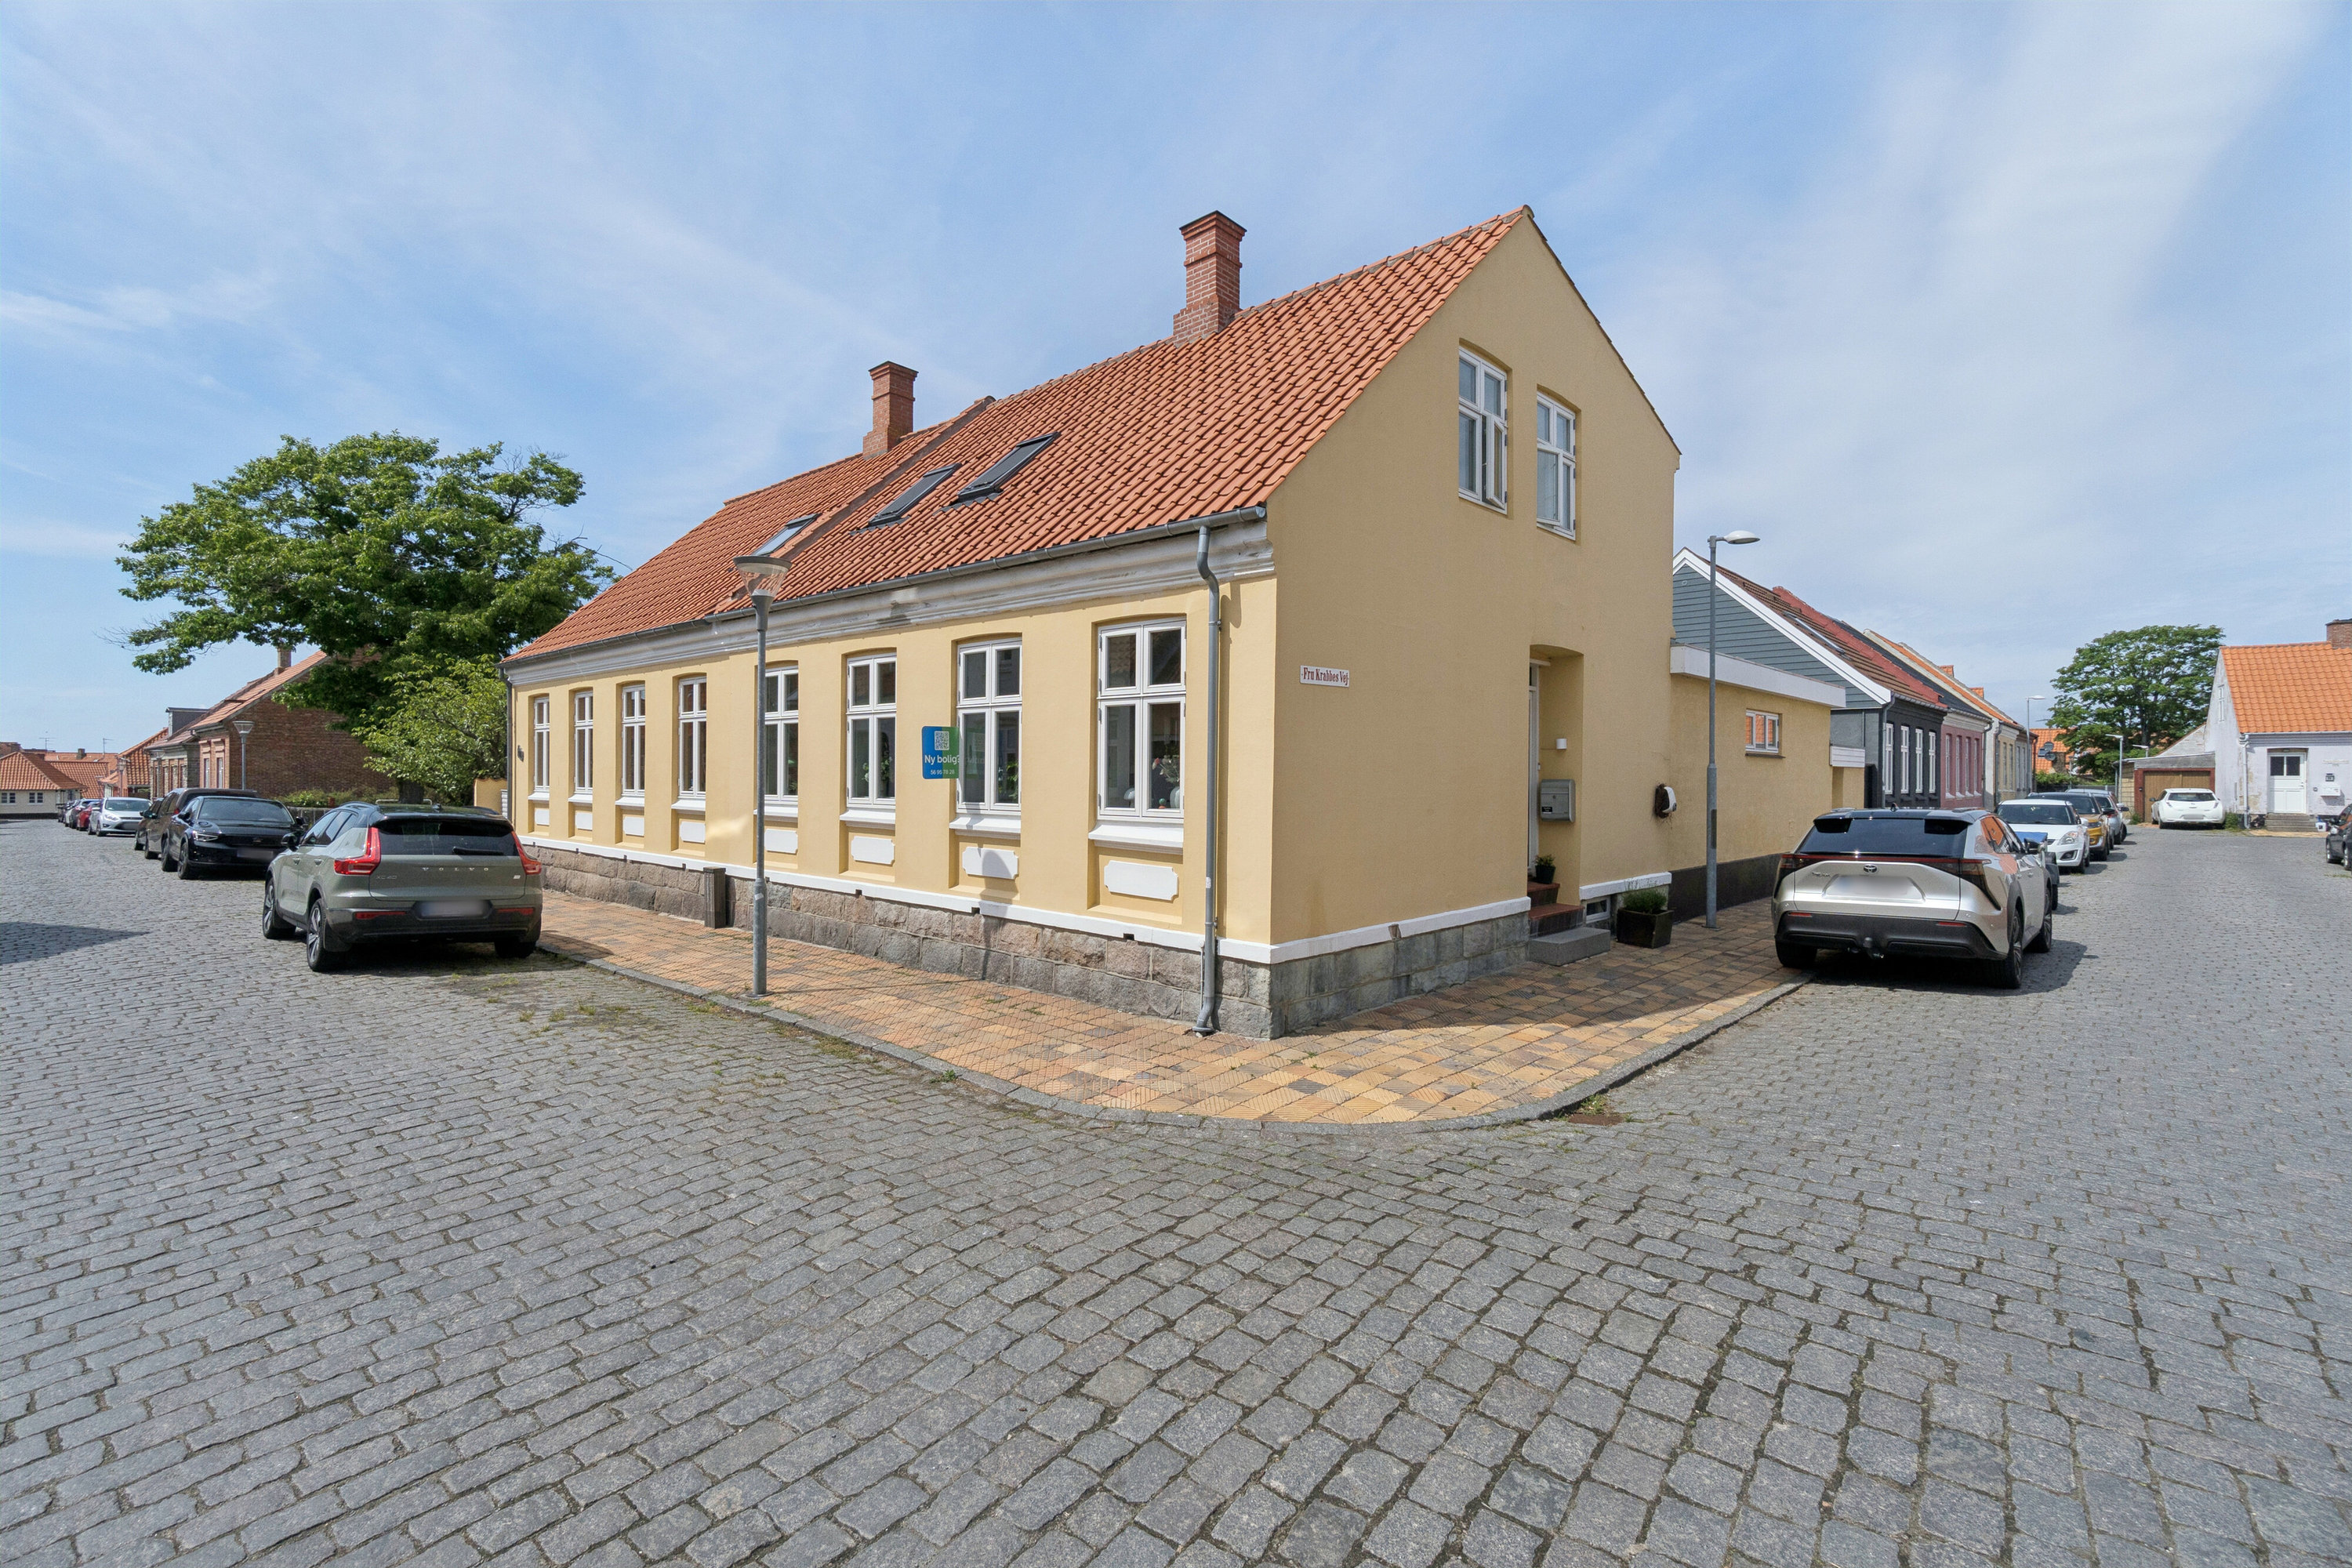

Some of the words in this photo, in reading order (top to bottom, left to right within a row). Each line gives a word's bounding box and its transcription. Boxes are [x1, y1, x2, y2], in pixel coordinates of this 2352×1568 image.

[1303, 667, 1315, 681] Fru
[1316, 668, 1339, 682] Krabbes
[1339, 670, 1348, 685] Vej
[924, 755, 935, 765] Ny
